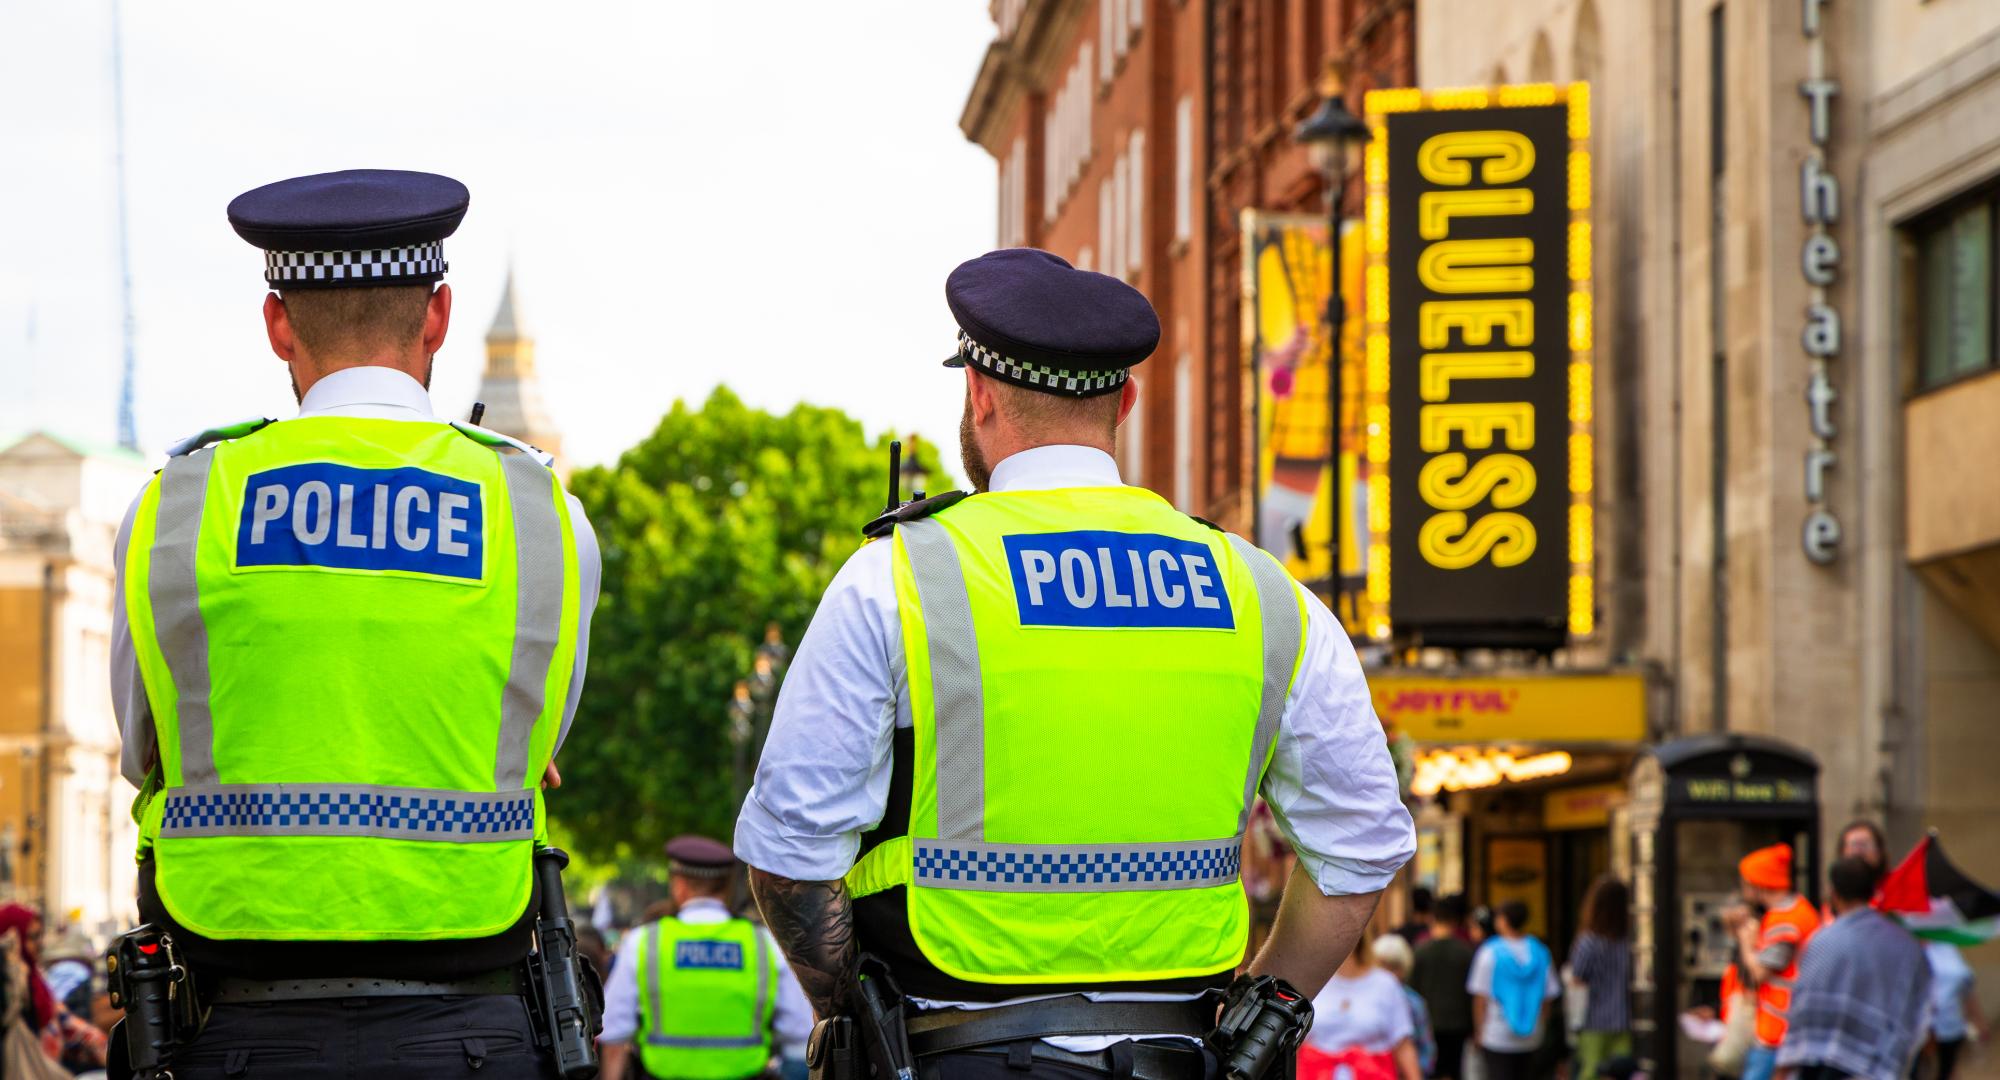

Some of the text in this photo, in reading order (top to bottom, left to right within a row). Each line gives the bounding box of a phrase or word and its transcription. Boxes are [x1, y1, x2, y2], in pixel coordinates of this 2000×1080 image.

[1417, 130, 1537, 570] CLUELESS
[1801, 80, 1841, 564] Theatre
[250, 480, 470, 557] POLICE
[1020, 547, 1221, 609] POLICE
[678, 942, 739, 965] POLICE
